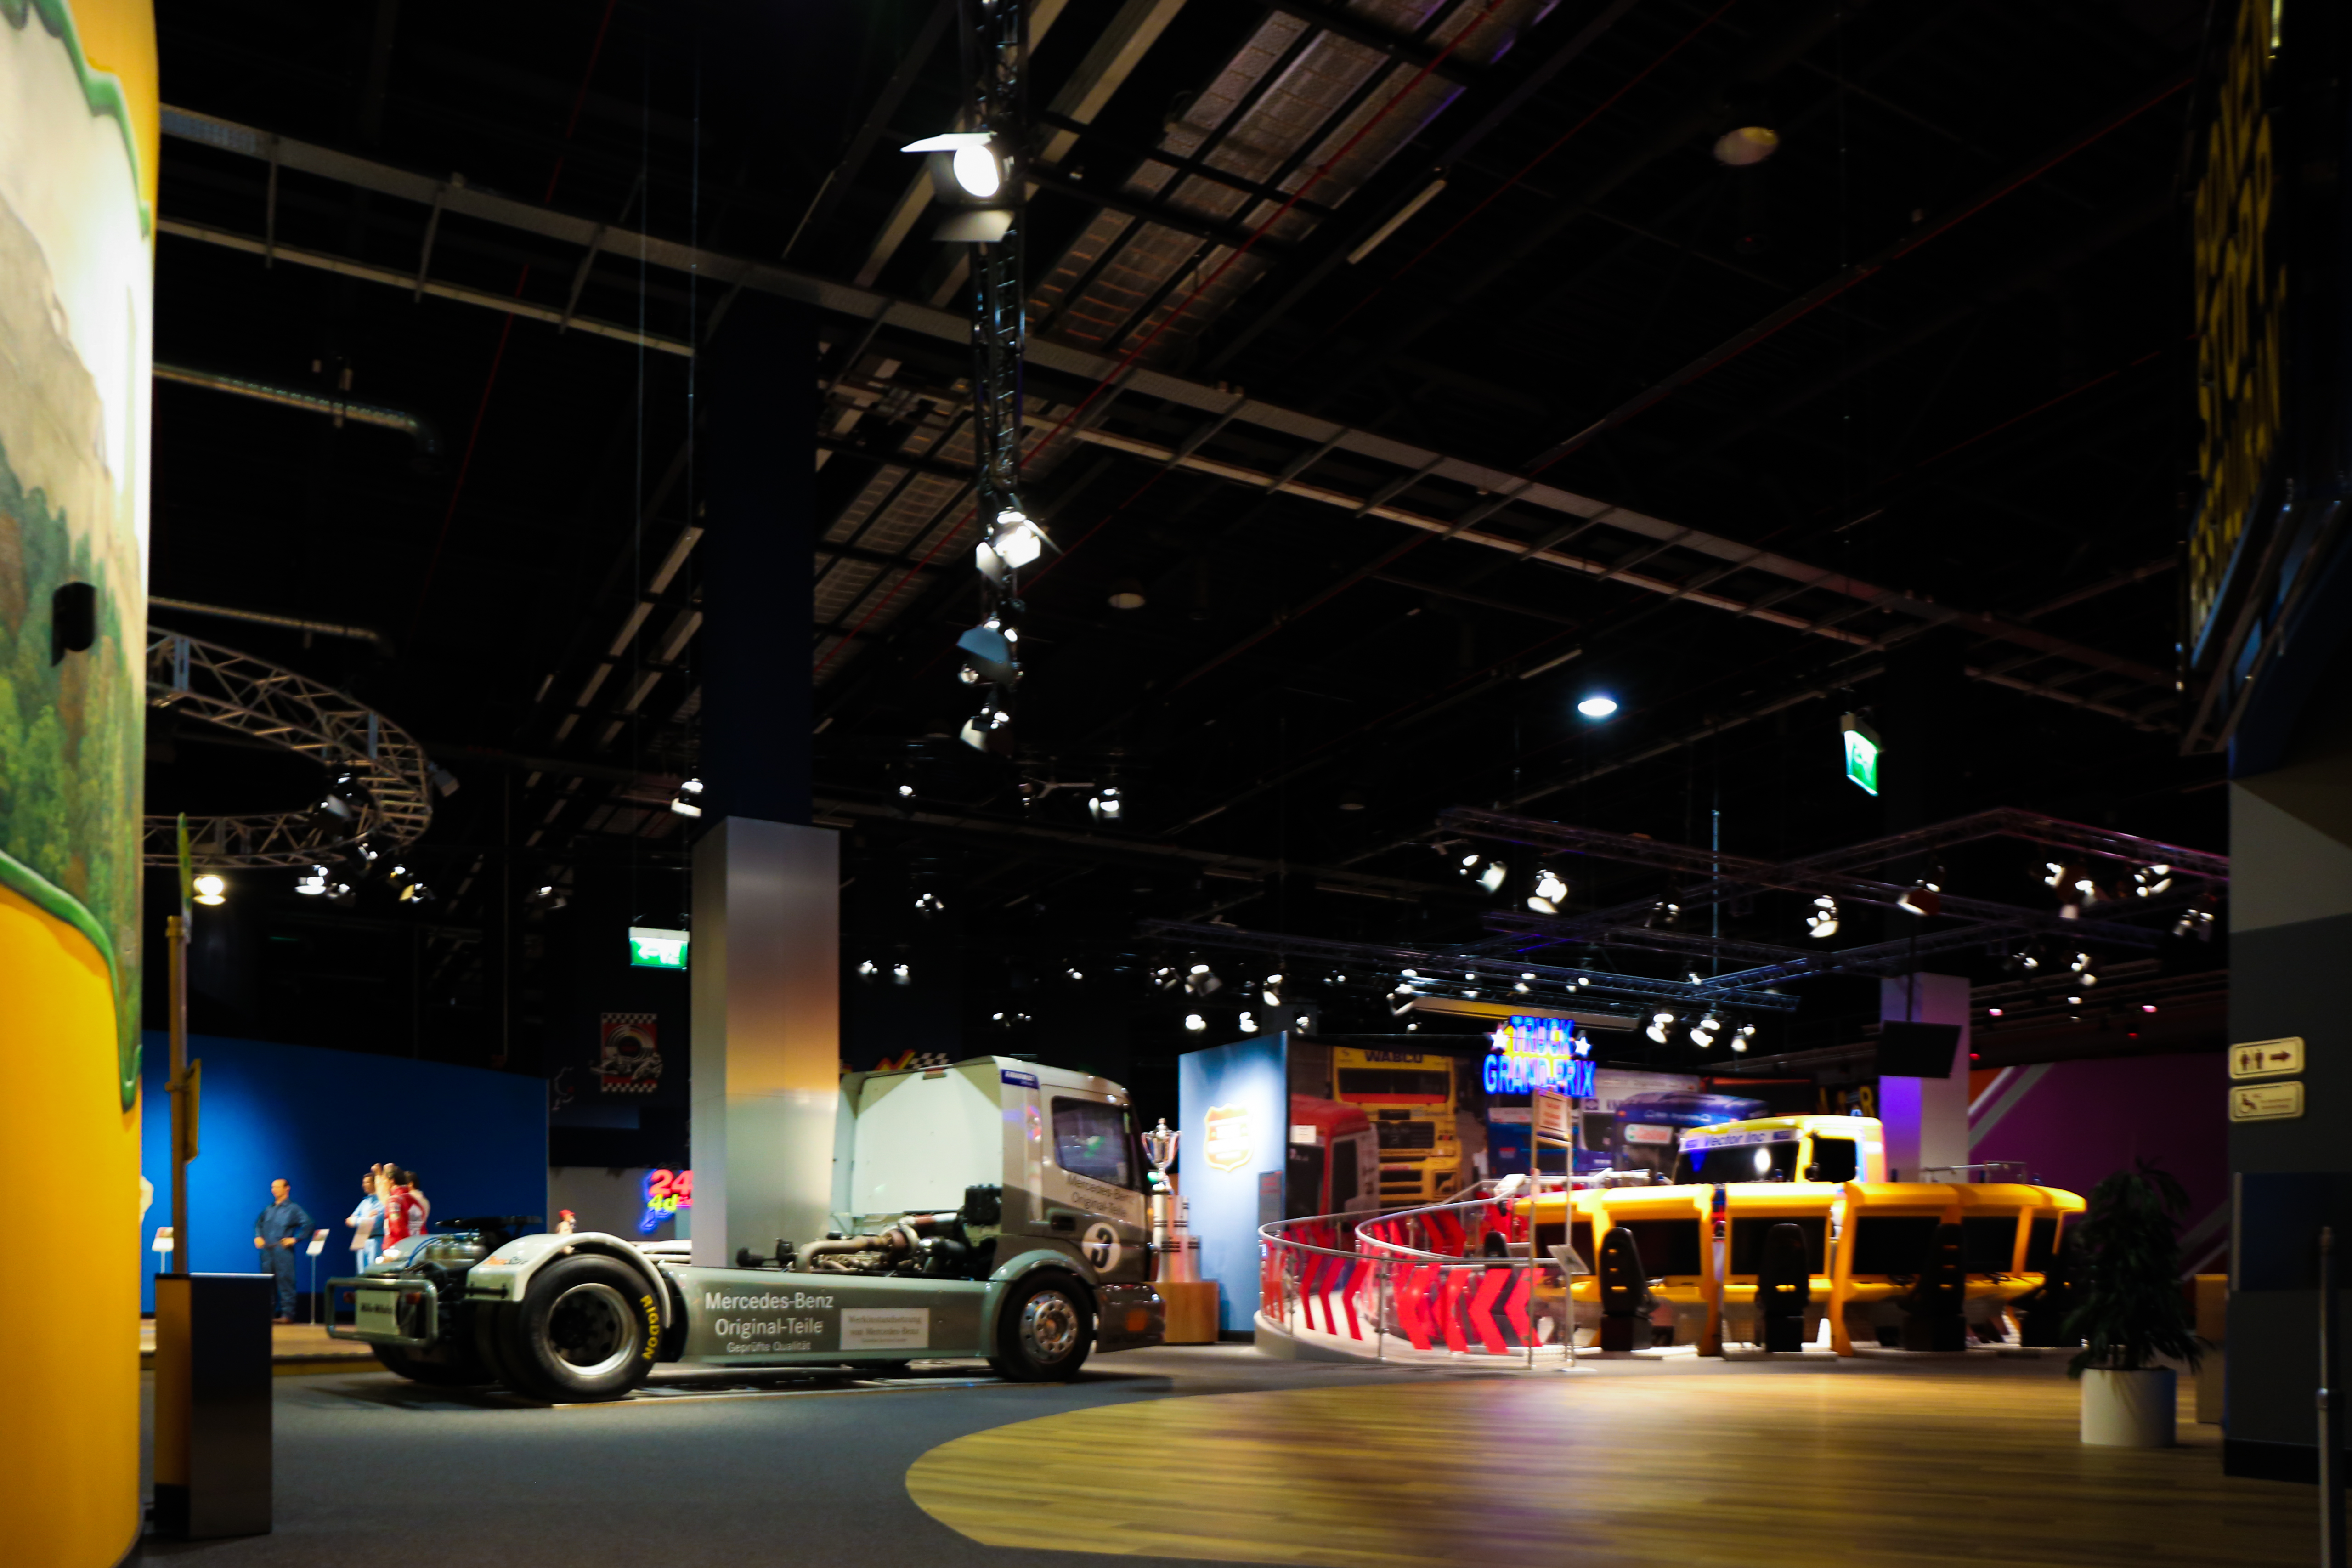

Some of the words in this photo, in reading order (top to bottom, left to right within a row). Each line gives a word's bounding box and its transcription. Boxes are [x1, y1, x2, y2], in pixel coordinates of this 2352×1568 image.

[1510, 1015, 1575, 1055] TRUCK
[1091, 1227, 1113, 1268] 3
[705, 1292, 834, 1309] Mercedes-Benz
[640, 1294, 660, 1360] RIGDON
[715, 1318, 824, 1339] Original-Teile
[726, 1341, 771, 1354] Geprüfte
[772, 1340, 811, 1352] Qualität
